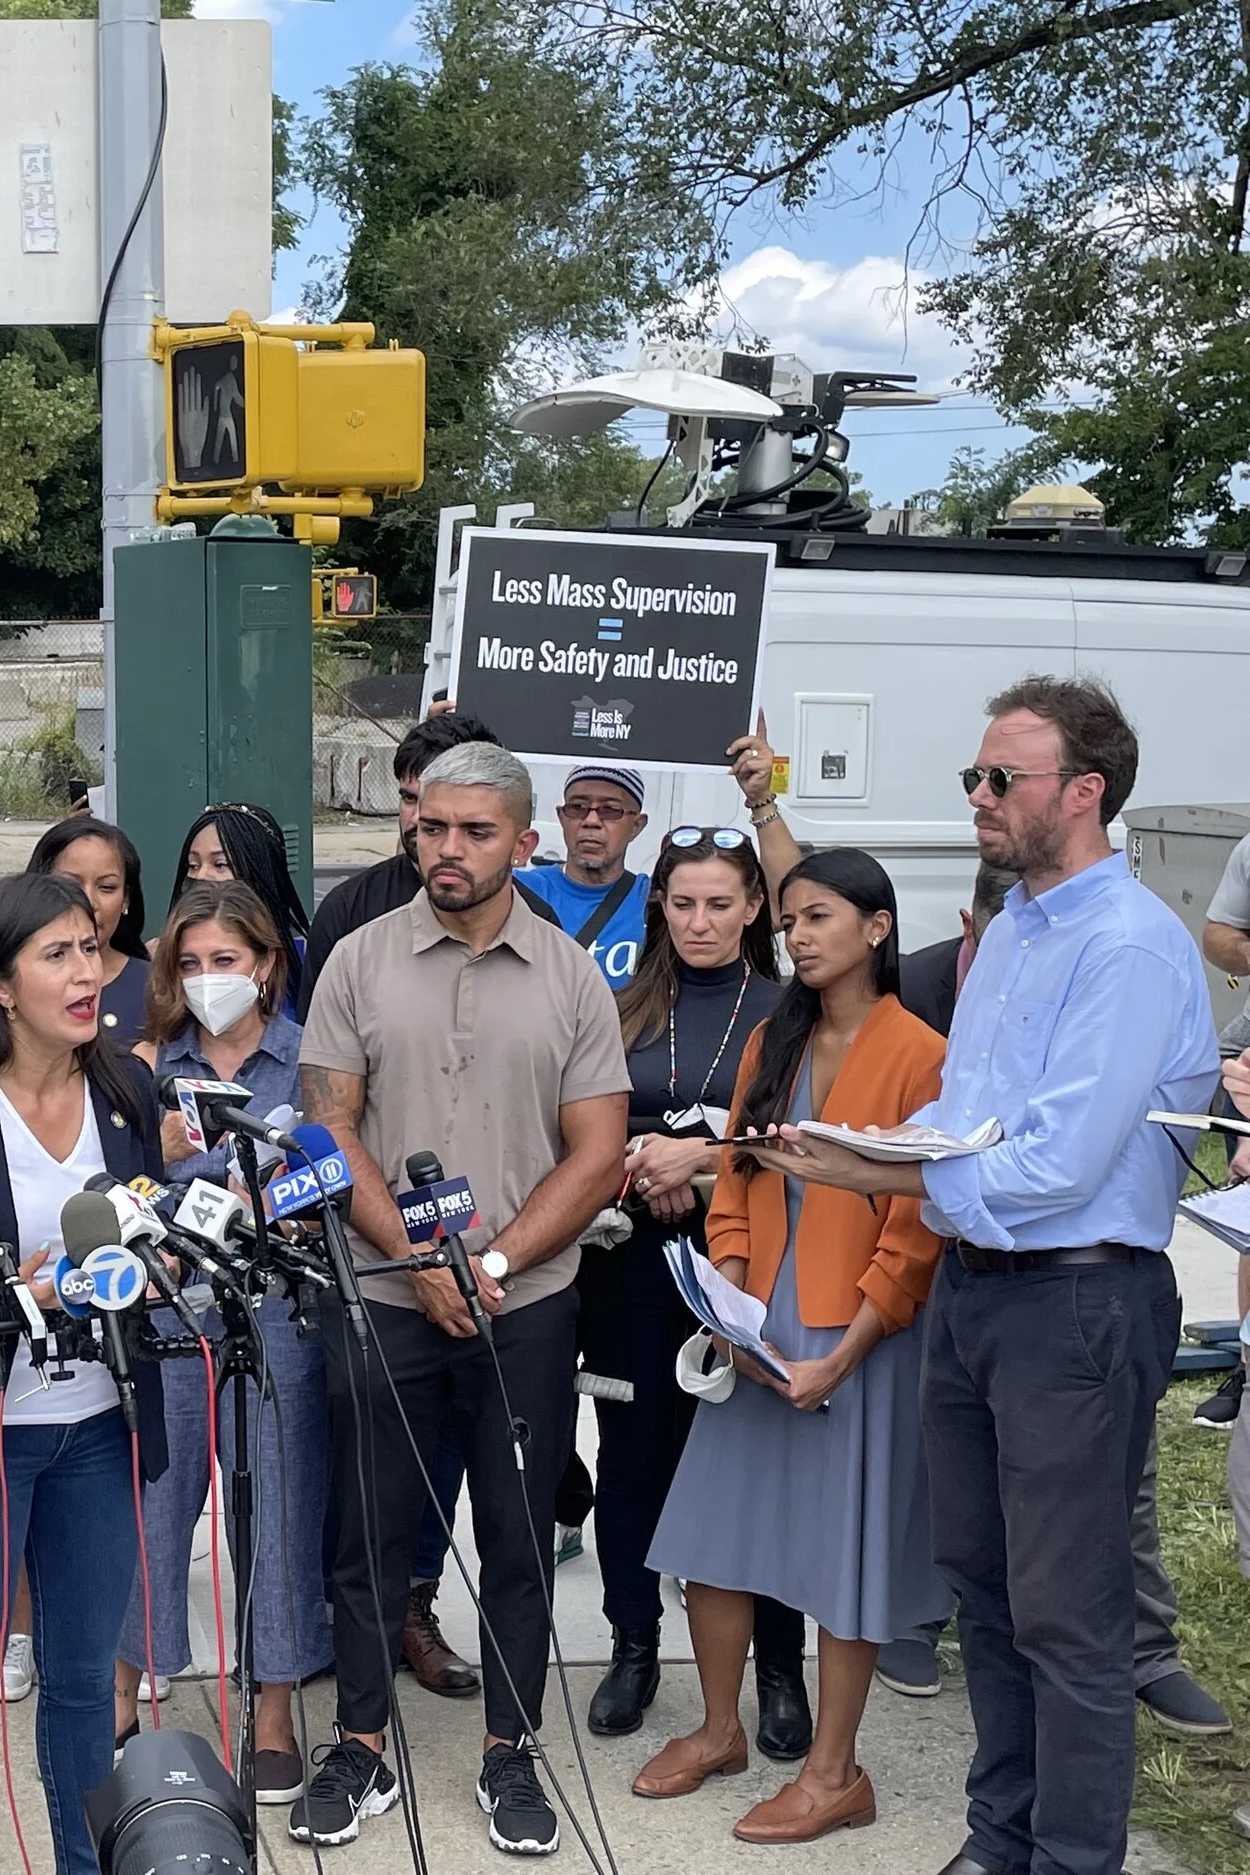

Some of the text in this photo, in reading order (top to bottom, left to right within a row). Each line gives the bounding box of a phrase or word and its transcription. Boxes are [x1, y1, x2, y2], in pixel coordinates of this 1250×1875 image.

[492, 570, 737, 618] Less Mass Supervision
[477, 636, 739, 684] More Safety and Justice
[591, 707, 614, 724] Less
[613, 709, 623, 725] Is
[590, 722, 615, 739] More
[615, 724, 631, 740] NY
[128, 1176, 160, 1198] 2
[272, 1161, 340, 1206] PIX 11
[148, 1188, 170, 1205] WS
[191, 1190, 224, 1229] 41
[61, 1275, 95, 1296] abc
